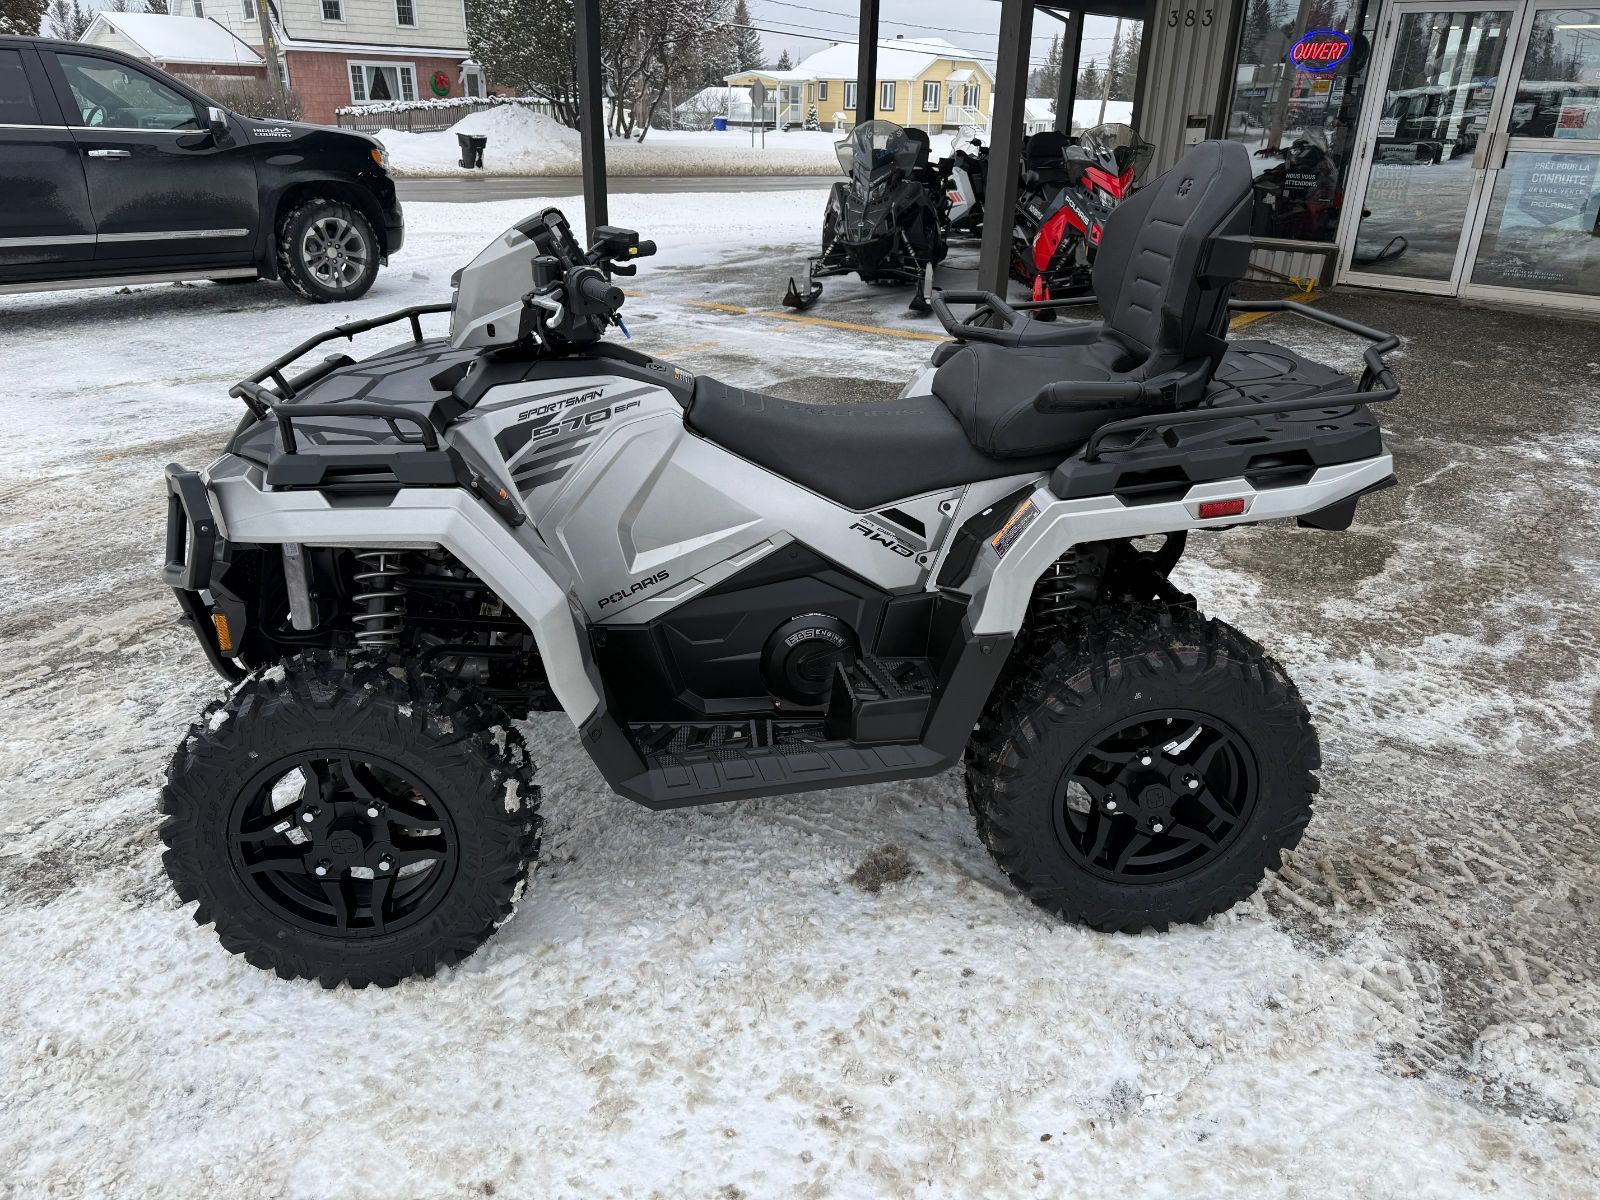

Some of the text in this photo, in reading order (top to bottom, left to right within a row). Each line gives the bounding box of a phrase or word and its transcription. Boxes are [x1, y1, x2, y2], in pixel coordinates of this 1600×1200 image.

[1168, 9, 1213, 27] 383
[1293, 42, 1347, 60] OUVERT
[1534, 161, 1590, 172] PRÊT POUR LA
[1531, 173, 1589, 186] CONDUITE
[1065, 195, 1090, 226] POLARIS
[1530, 201, 1574, 209] POLARIS
[517, 388, 604, 422] SPORTSMAN
[532, 400, 641, 442] 570 EFI
[848, 522, 915, 558] AWD
[597, 569, 670, 609] POLARIS
[815, 629, 844, 645] ENGINE
